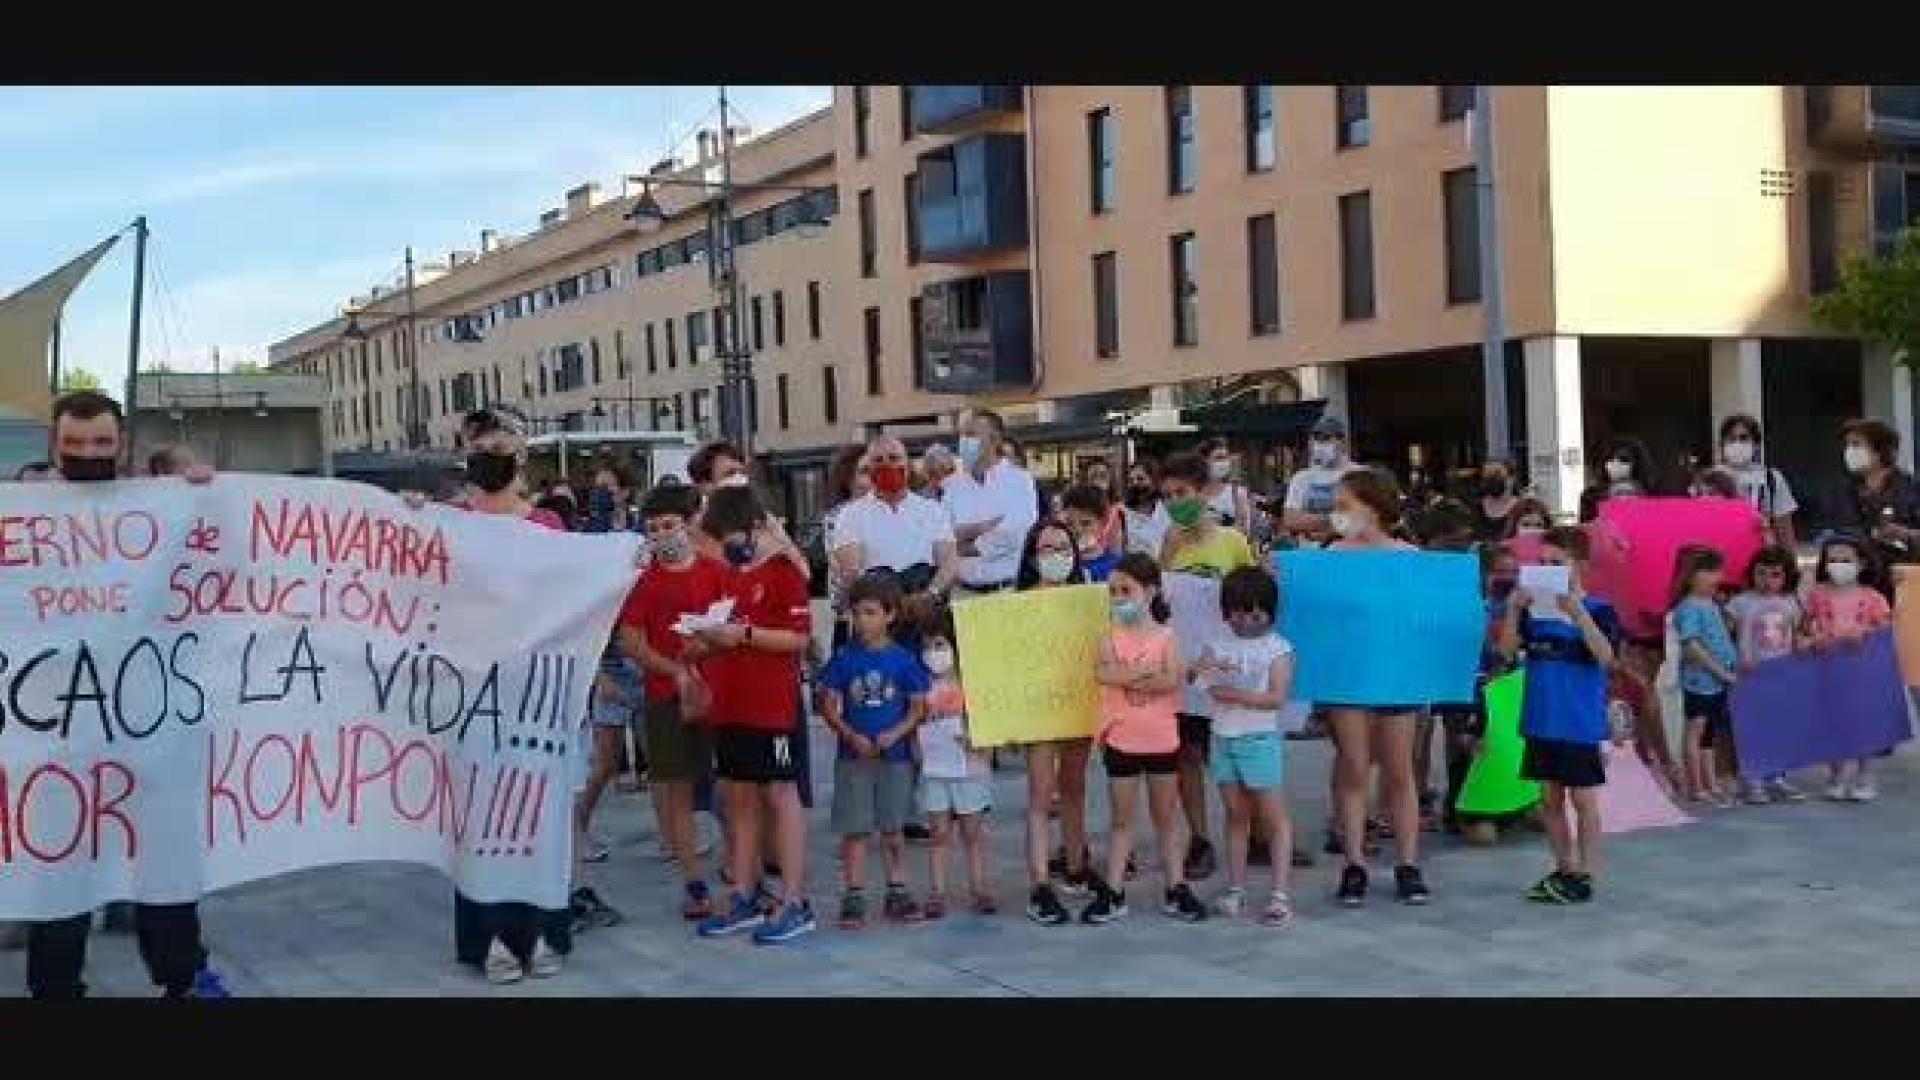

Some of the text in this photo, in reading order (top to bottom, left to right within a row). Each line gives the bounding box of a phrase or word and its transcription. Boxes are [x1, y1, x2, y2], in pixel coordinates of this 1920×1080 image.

[185, 516, 220, 553] de
[252, 499, 449, 585] NAVARRA
[0, 632, 205, 743] CAOS
[240, 627, 326, 703] LA
